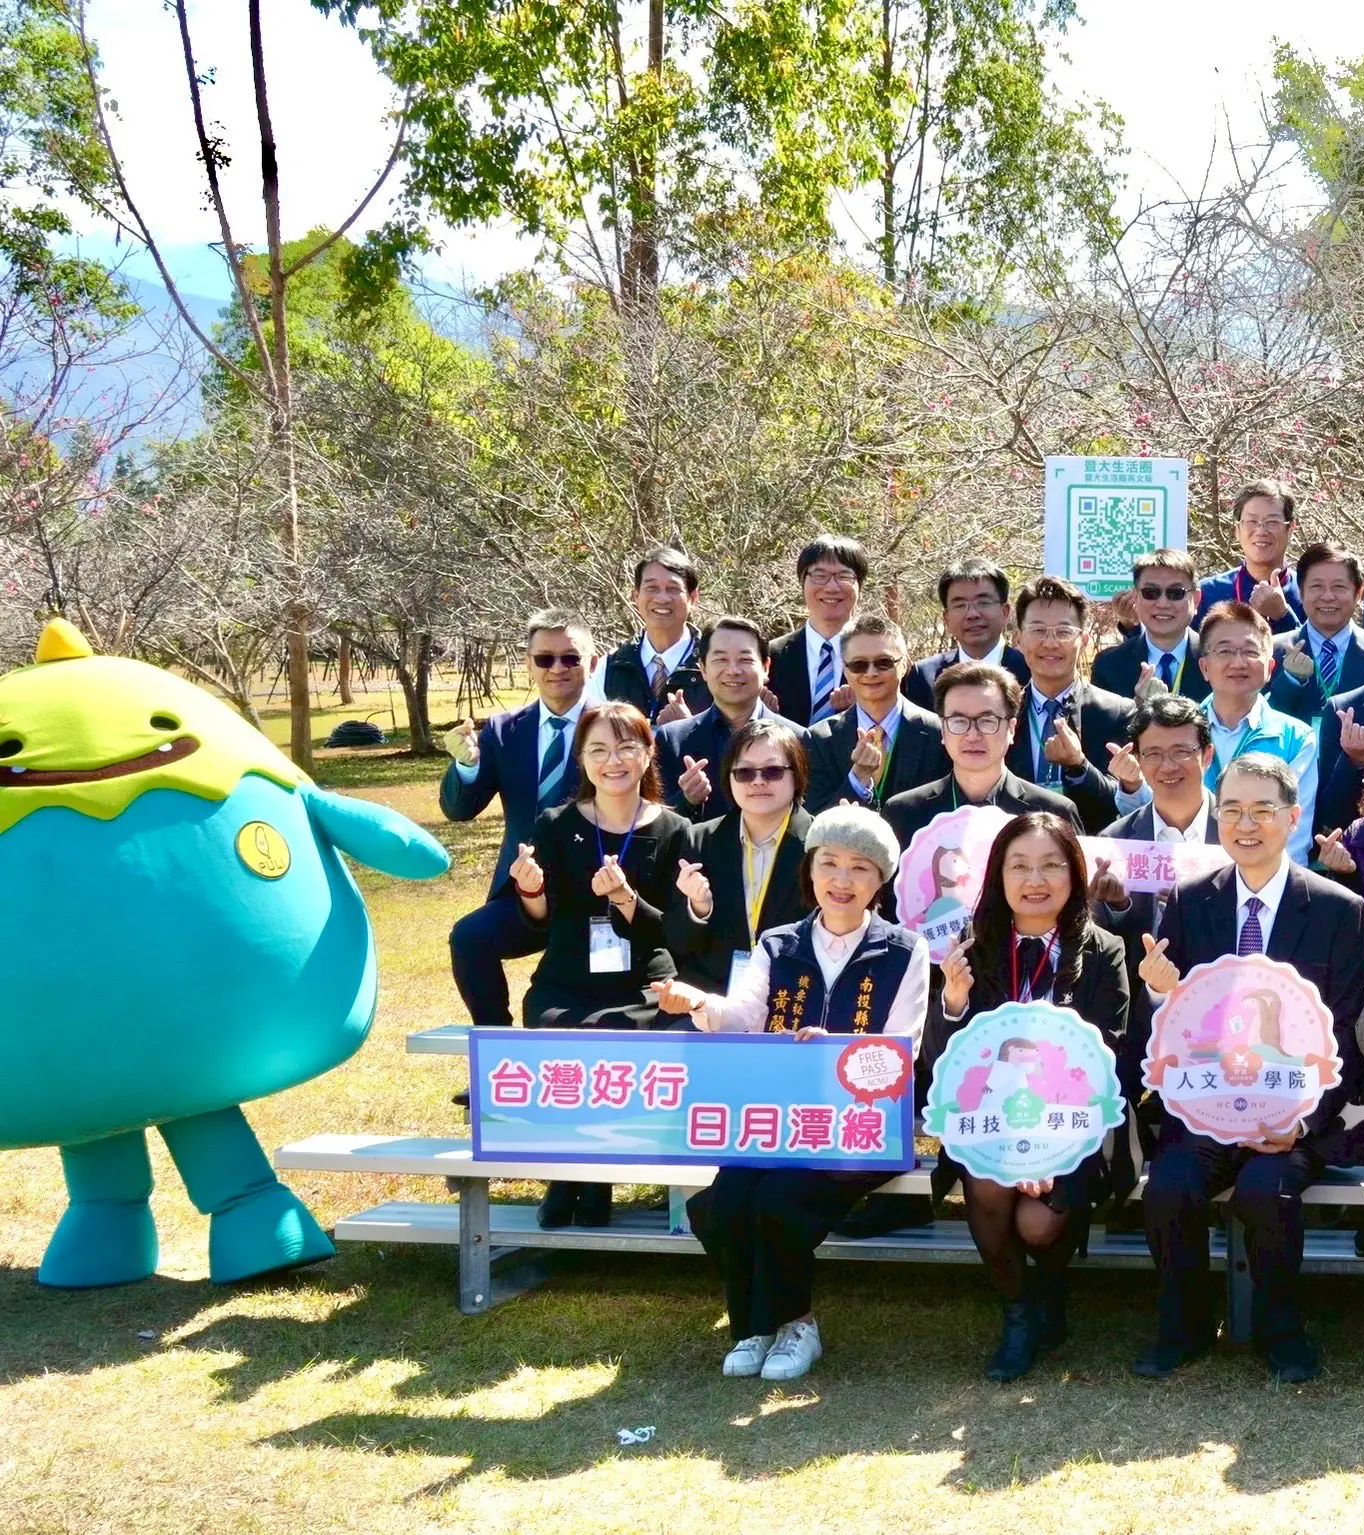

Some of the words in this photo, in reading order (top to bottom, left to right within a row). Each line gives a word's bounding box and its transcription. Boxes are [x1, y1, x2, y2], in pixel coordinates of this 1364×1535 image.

[1084, 459, 1152, 474] 暨大生活圈
[259, 857, 285, 873] PULI
[858, 1050, 885, 1064] FREE
[861, 1061, 888, 1076] PASS
[490, 1060, 686, 1108] 台灣好行
[867, 1076, 889, 1087] NCNU
[1176, 1071, 1218, 1090] 人文
[1264, 1070, 1306, 1090] 學院
[690, 1105, 887, 1151] 日月潭線
[958, 1115, 1001, 1135] 科技
[1047, 1111, 1090, 1131] 學院
